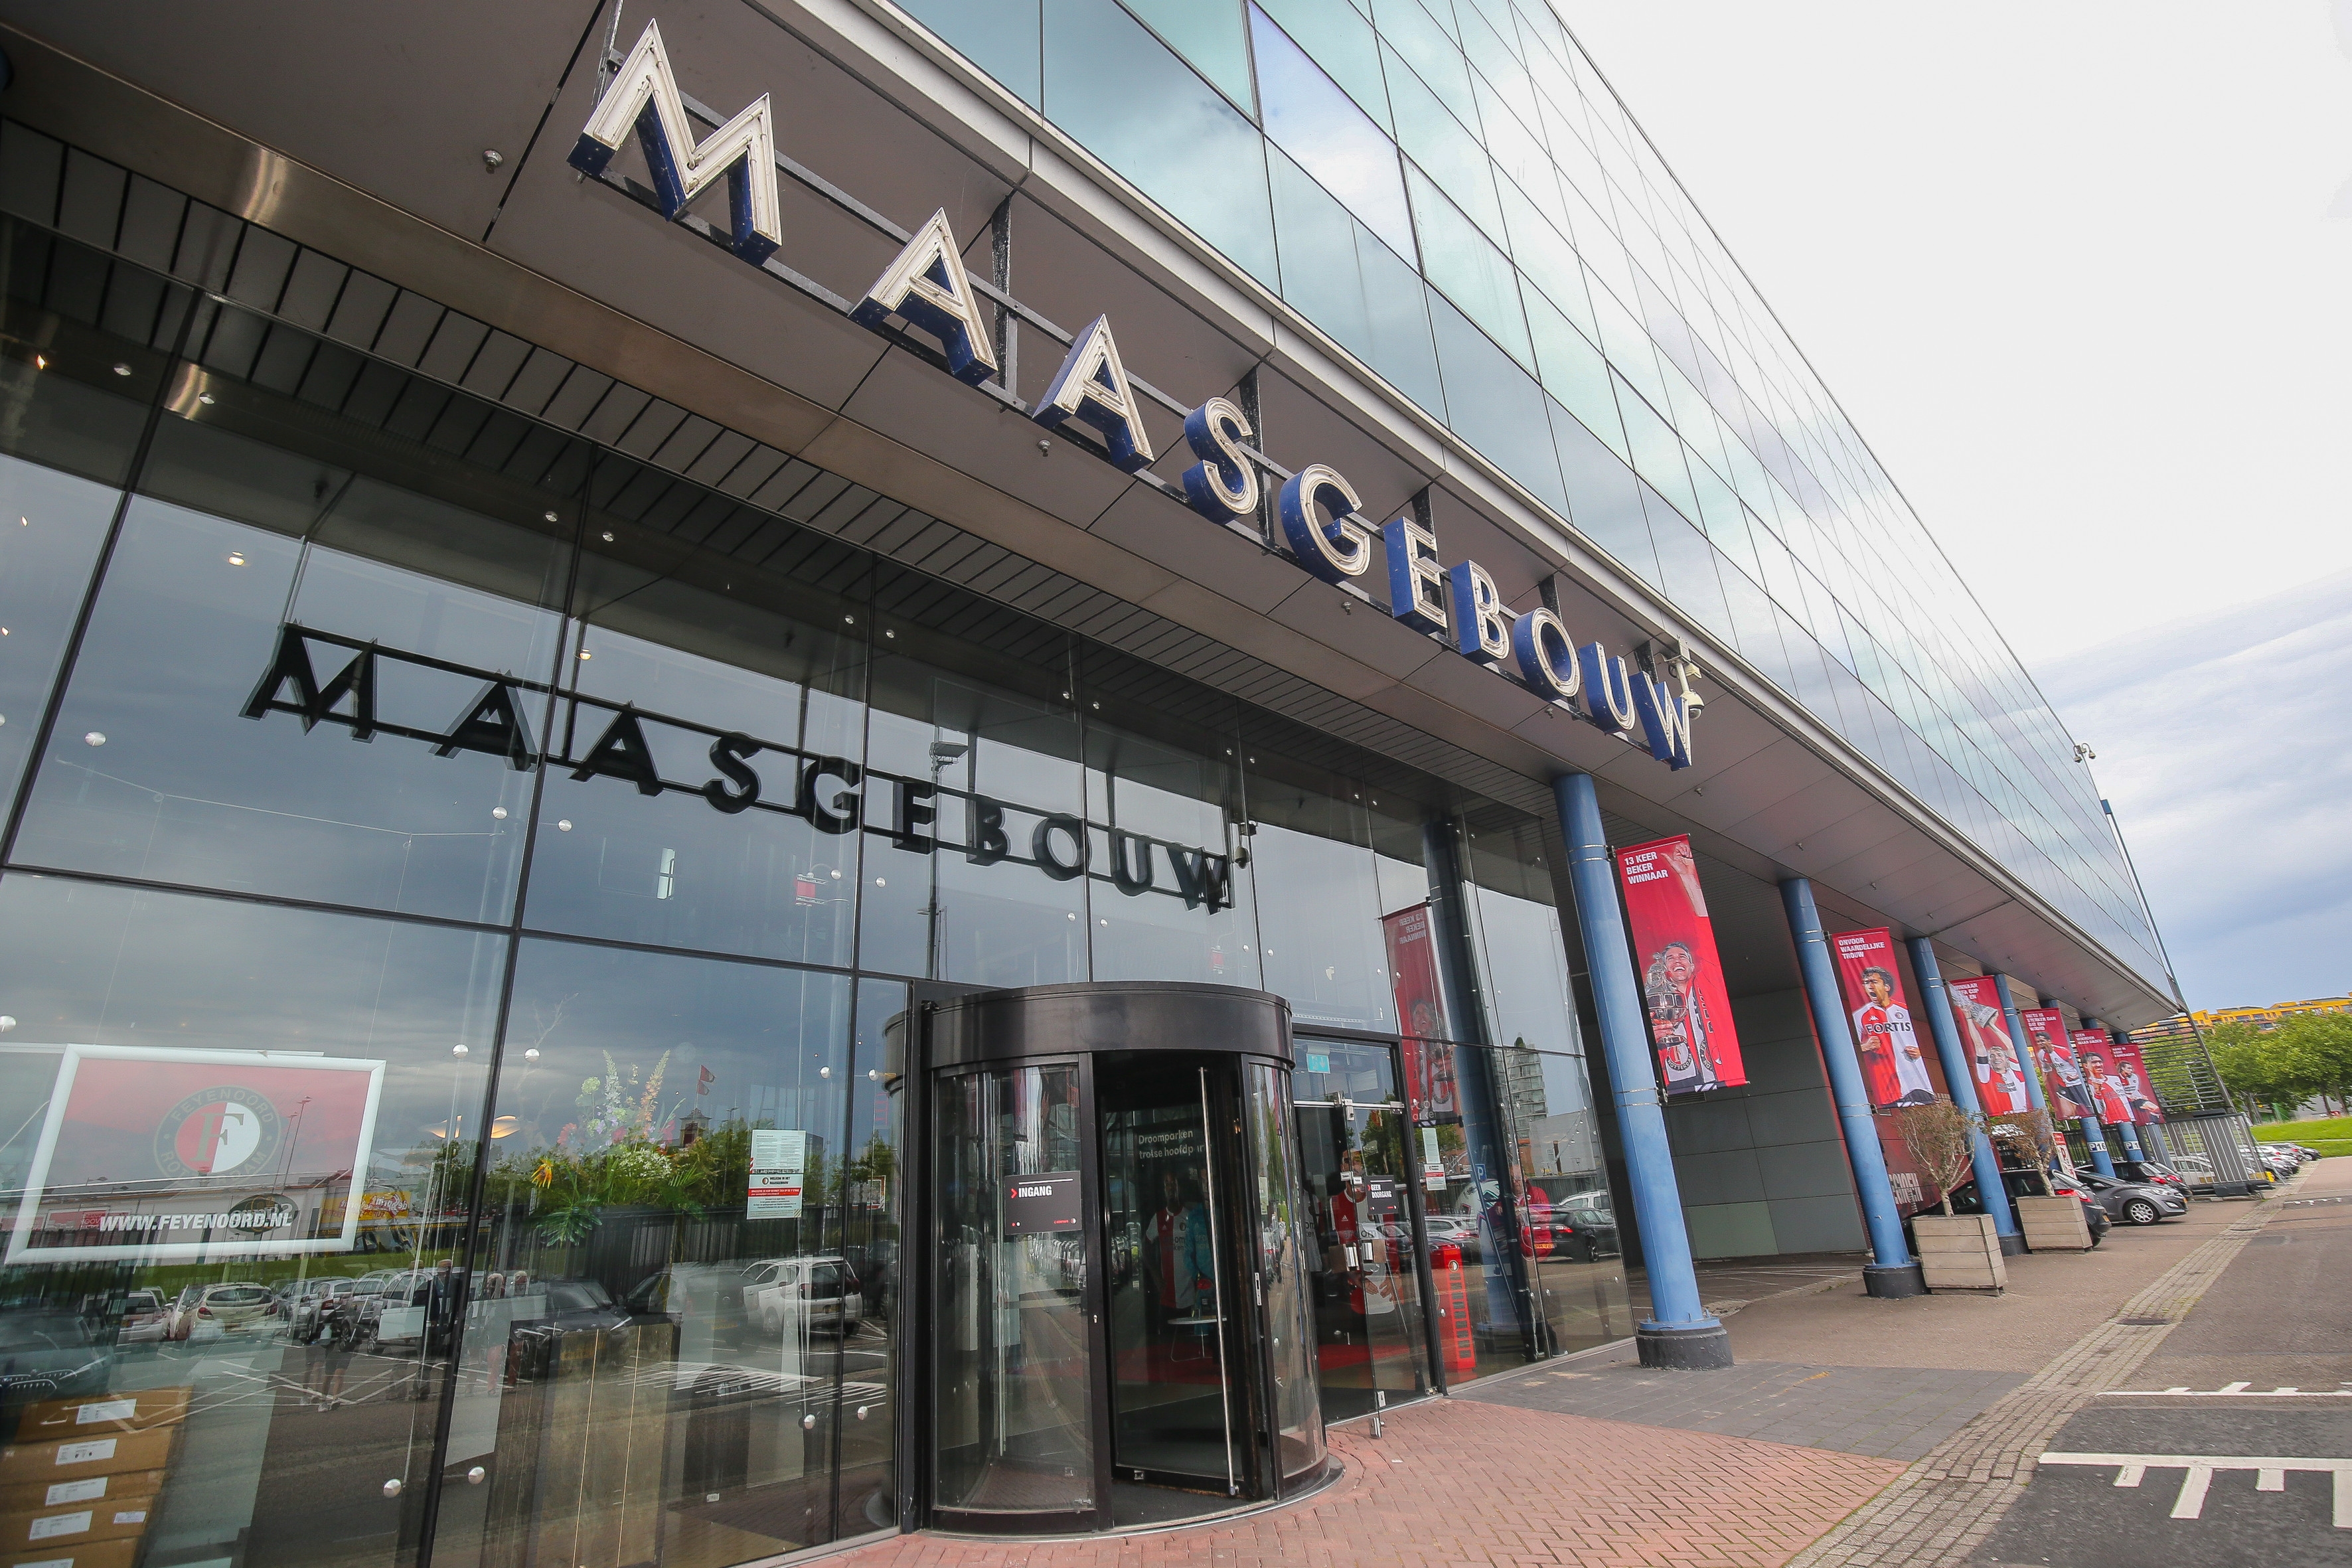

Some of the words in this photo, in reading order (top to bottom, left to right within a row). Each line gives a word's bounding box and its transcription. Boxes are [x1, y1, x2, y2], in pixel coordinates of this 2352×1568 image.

[568, 19, 1692, 770] MAASGEBOUW
[238, 621, 1232, 913] MAASGEBOUW
[1624, 857, 1634, 866] 13
[1636, 852, 1658, 863] KEER
[1626, 862, 1654, 875] BEKER
[1628, 869, 1668, 884] WINNAAR
[1839, 937, 1865, 946] ONVOOR
[1840, 942, 1885, 953] WAARDELIJKE
[1865, 1022, 1911, 1034] FORTIS
[171, 1089, 274, 1122] FEYENOORD
[1138, 1129, 1194, 1144] Droomparken
[1139, 1149, 1162, 1159] trotse
[1477, 1166, 1484, 1180] P
[1018, 1186, 1052, 1198] INGANG
[100, 1212, 292, 1231] WWW.FEYENOORD.NL
